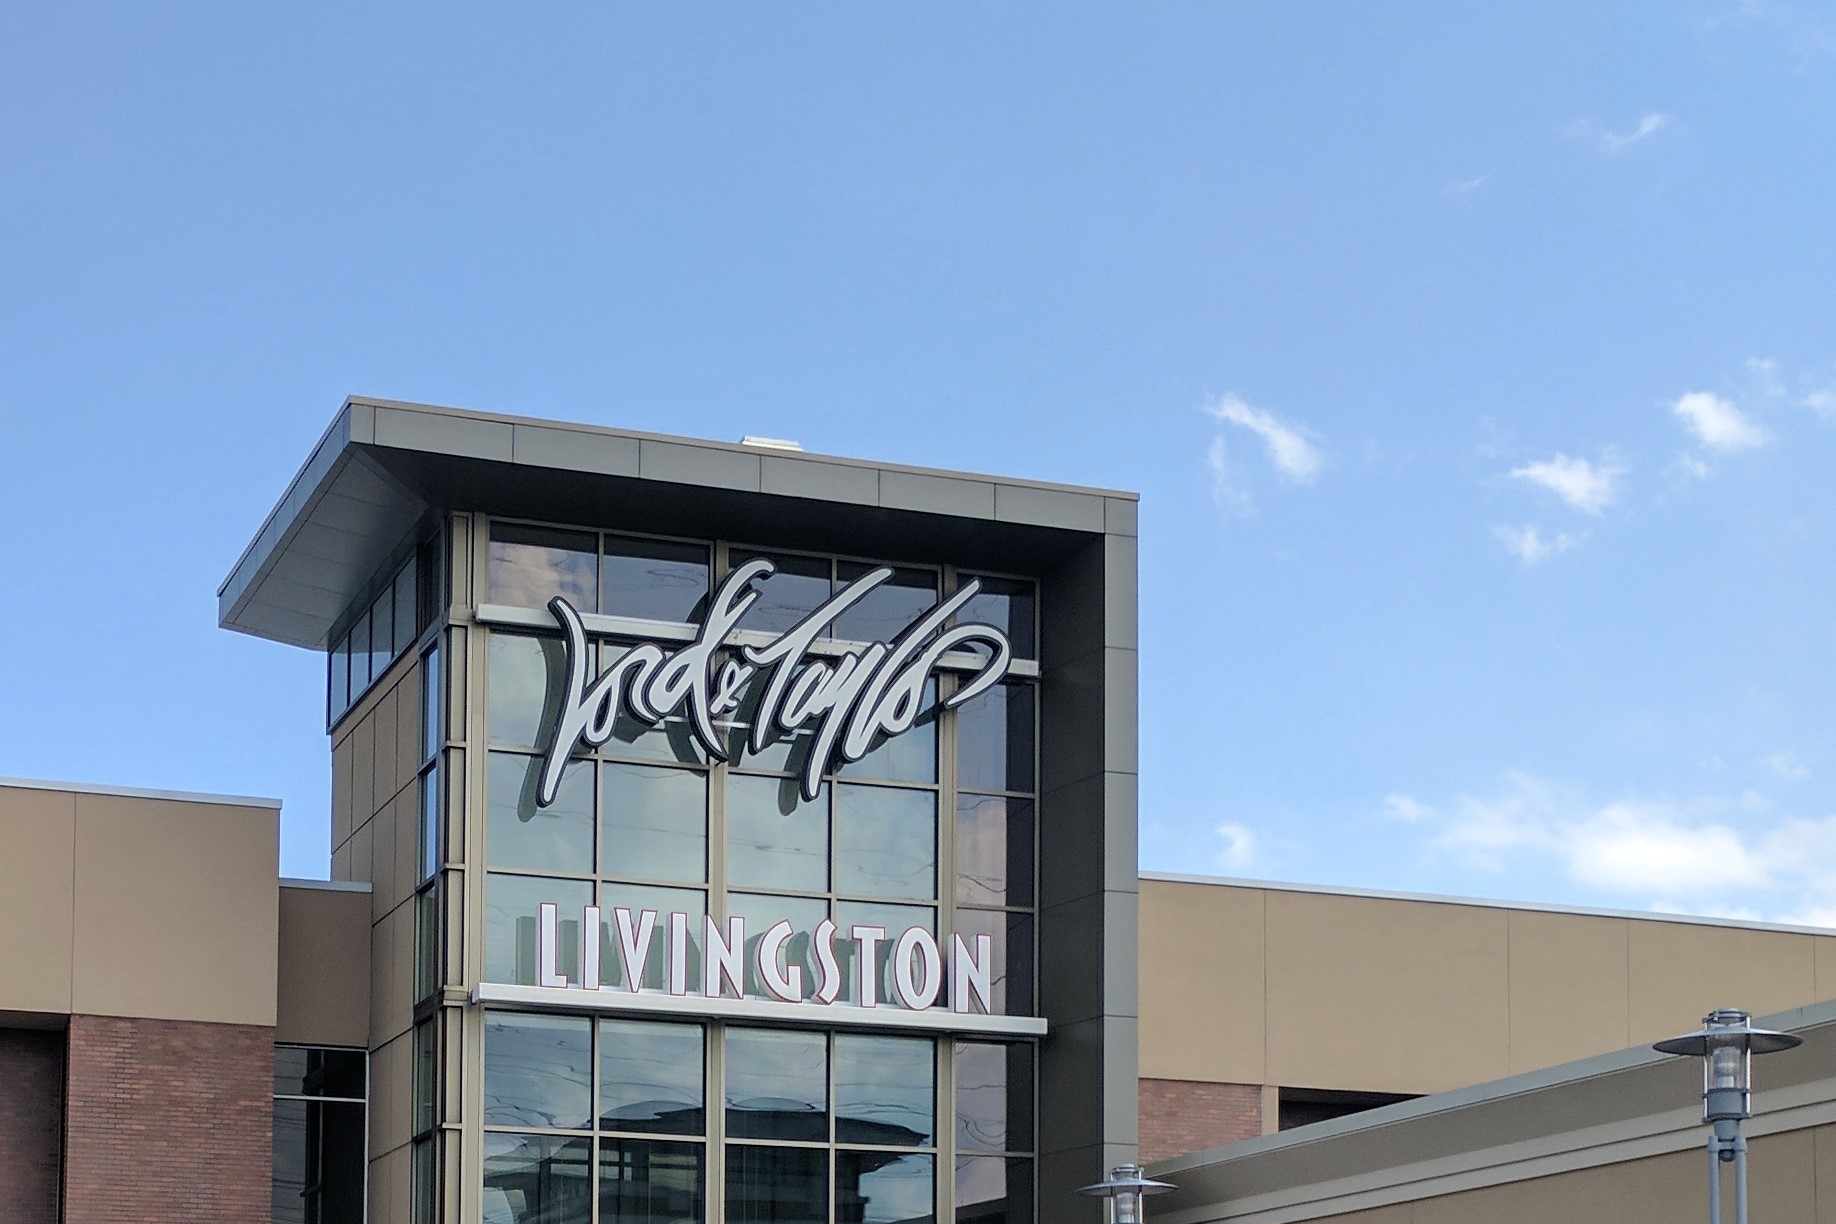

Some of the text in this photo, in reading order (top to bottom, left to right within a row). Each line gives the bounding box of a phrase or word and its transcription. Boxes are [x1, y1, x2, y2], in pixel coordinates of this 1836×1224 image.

[536, 558, 1012, 808] Lord & Taylor
[537, 902, 993, 1016] LIVINGSTON
